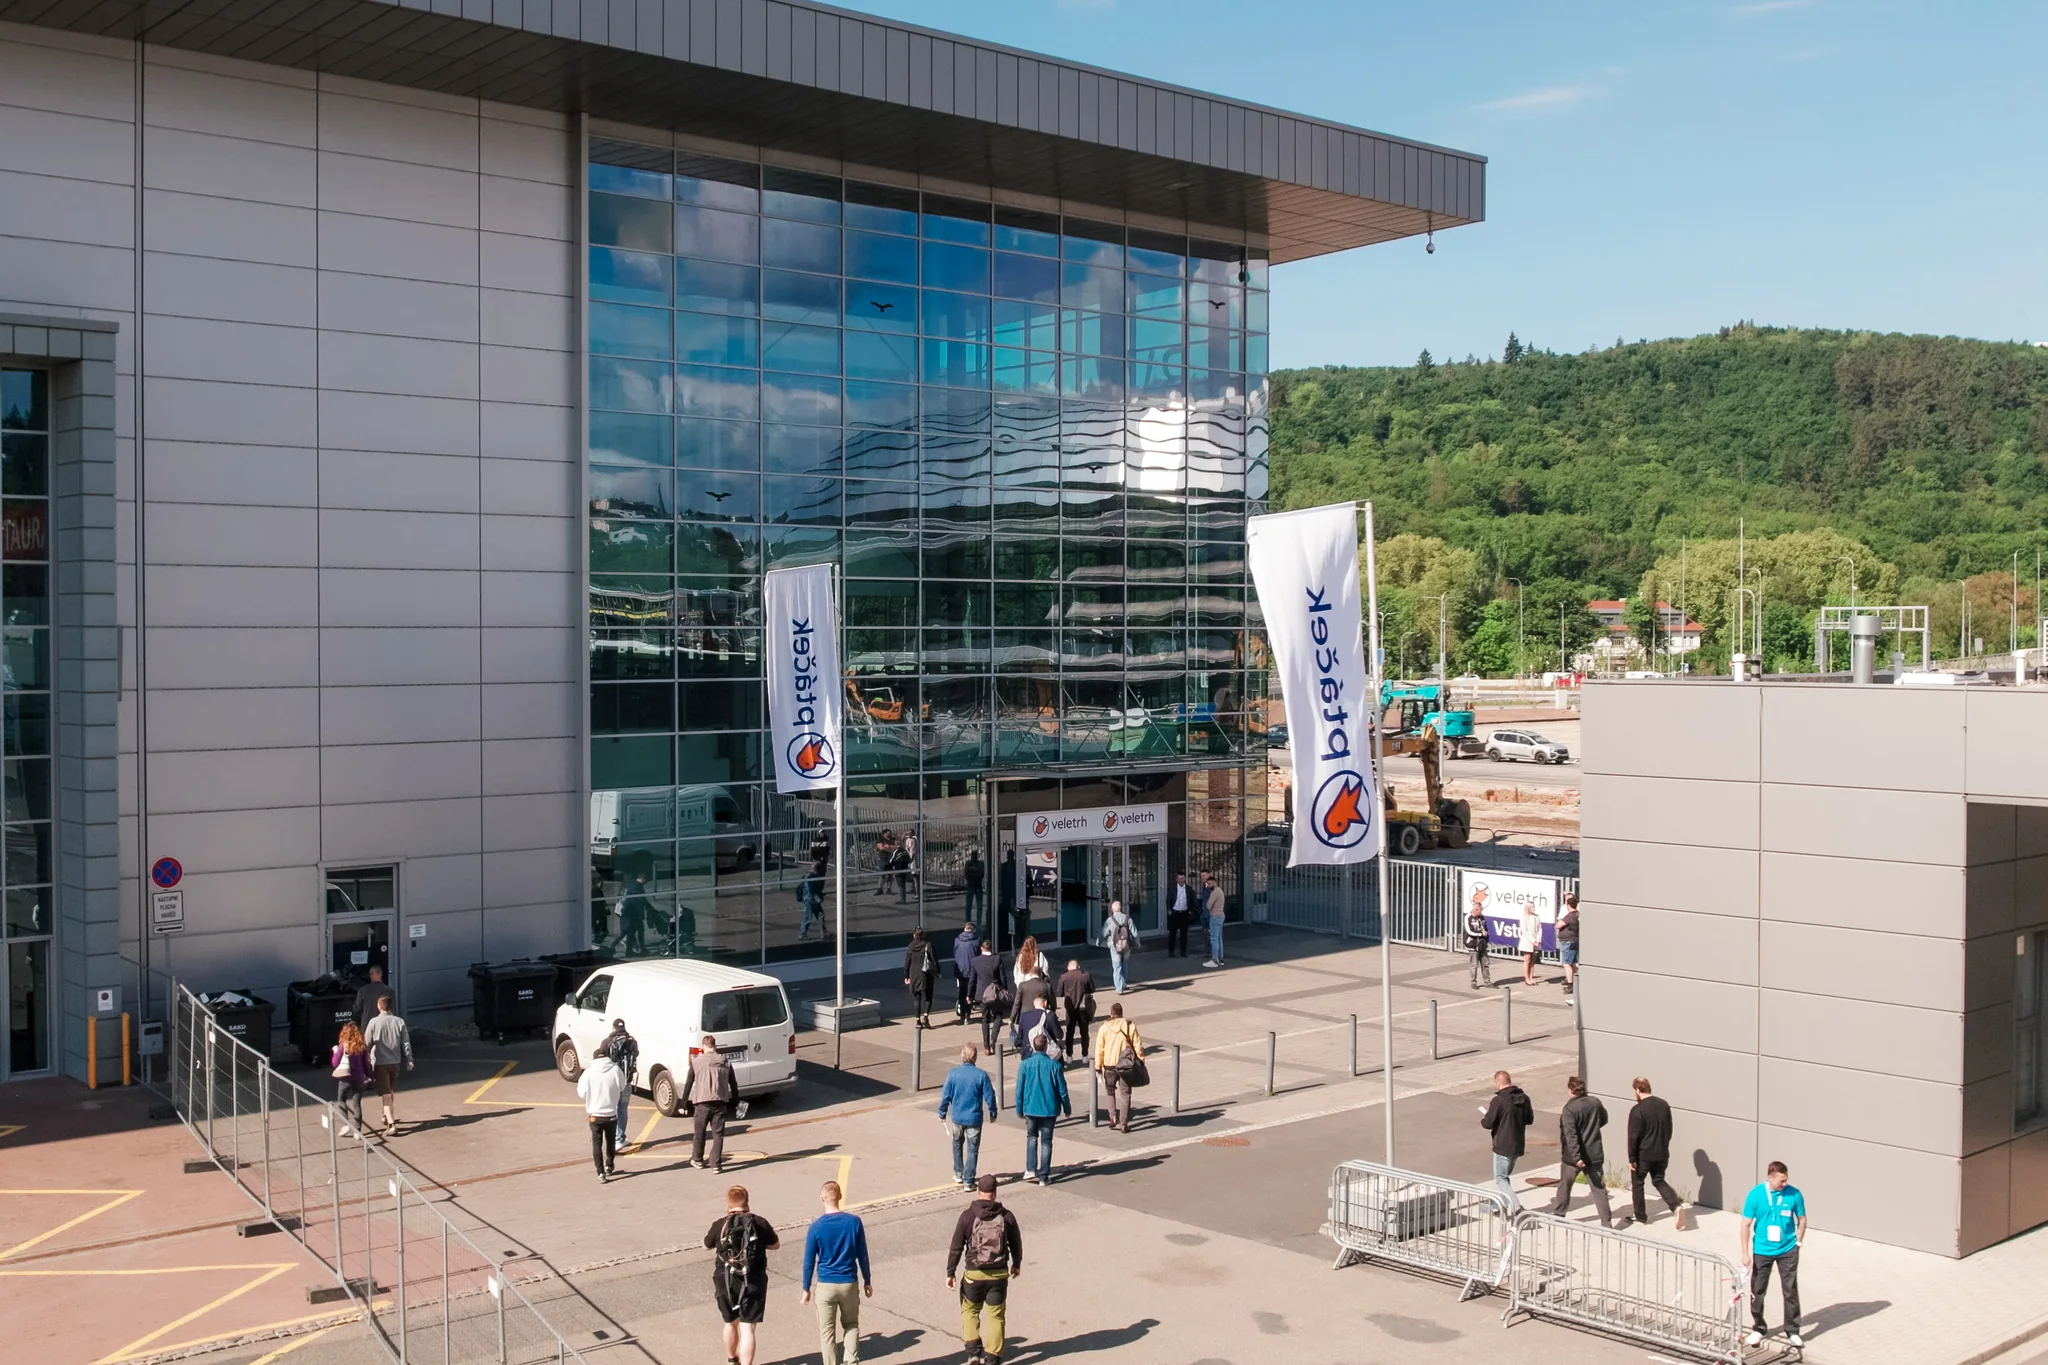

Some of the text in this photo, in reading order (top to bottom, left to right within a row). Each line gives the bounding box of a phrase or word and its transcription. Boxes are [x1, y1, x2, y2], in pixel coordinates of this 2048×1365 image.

[1052, 811, 1155, 830] veletrh veletrh
[1495, 890, 1548, 907] veletrh
